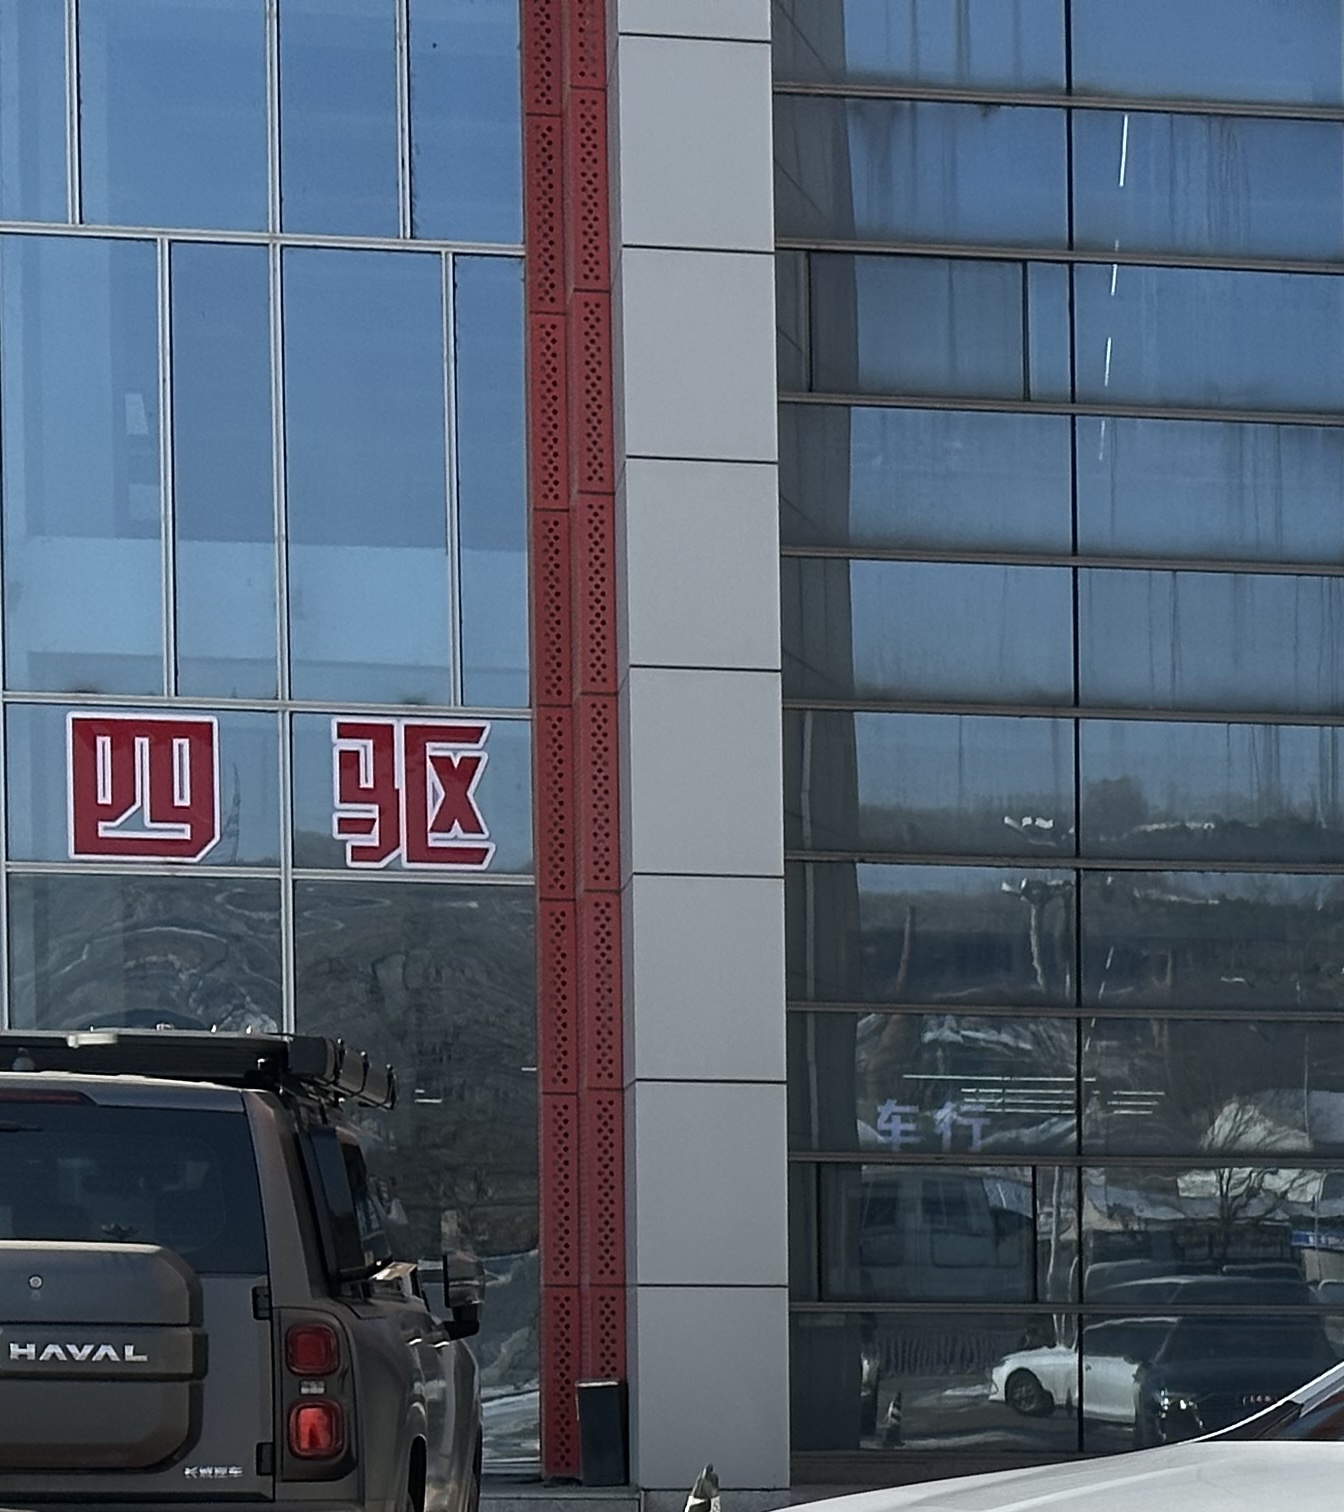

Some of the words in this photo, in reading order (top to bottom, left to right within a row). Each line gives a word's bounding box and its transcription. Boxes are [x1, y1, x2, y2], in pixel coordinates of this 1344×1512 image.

[67, 712, 495, 870] 四驱
[876, 1098, 990, 1153] 车行
[10, 1342, 148, 1363] HAVAL
